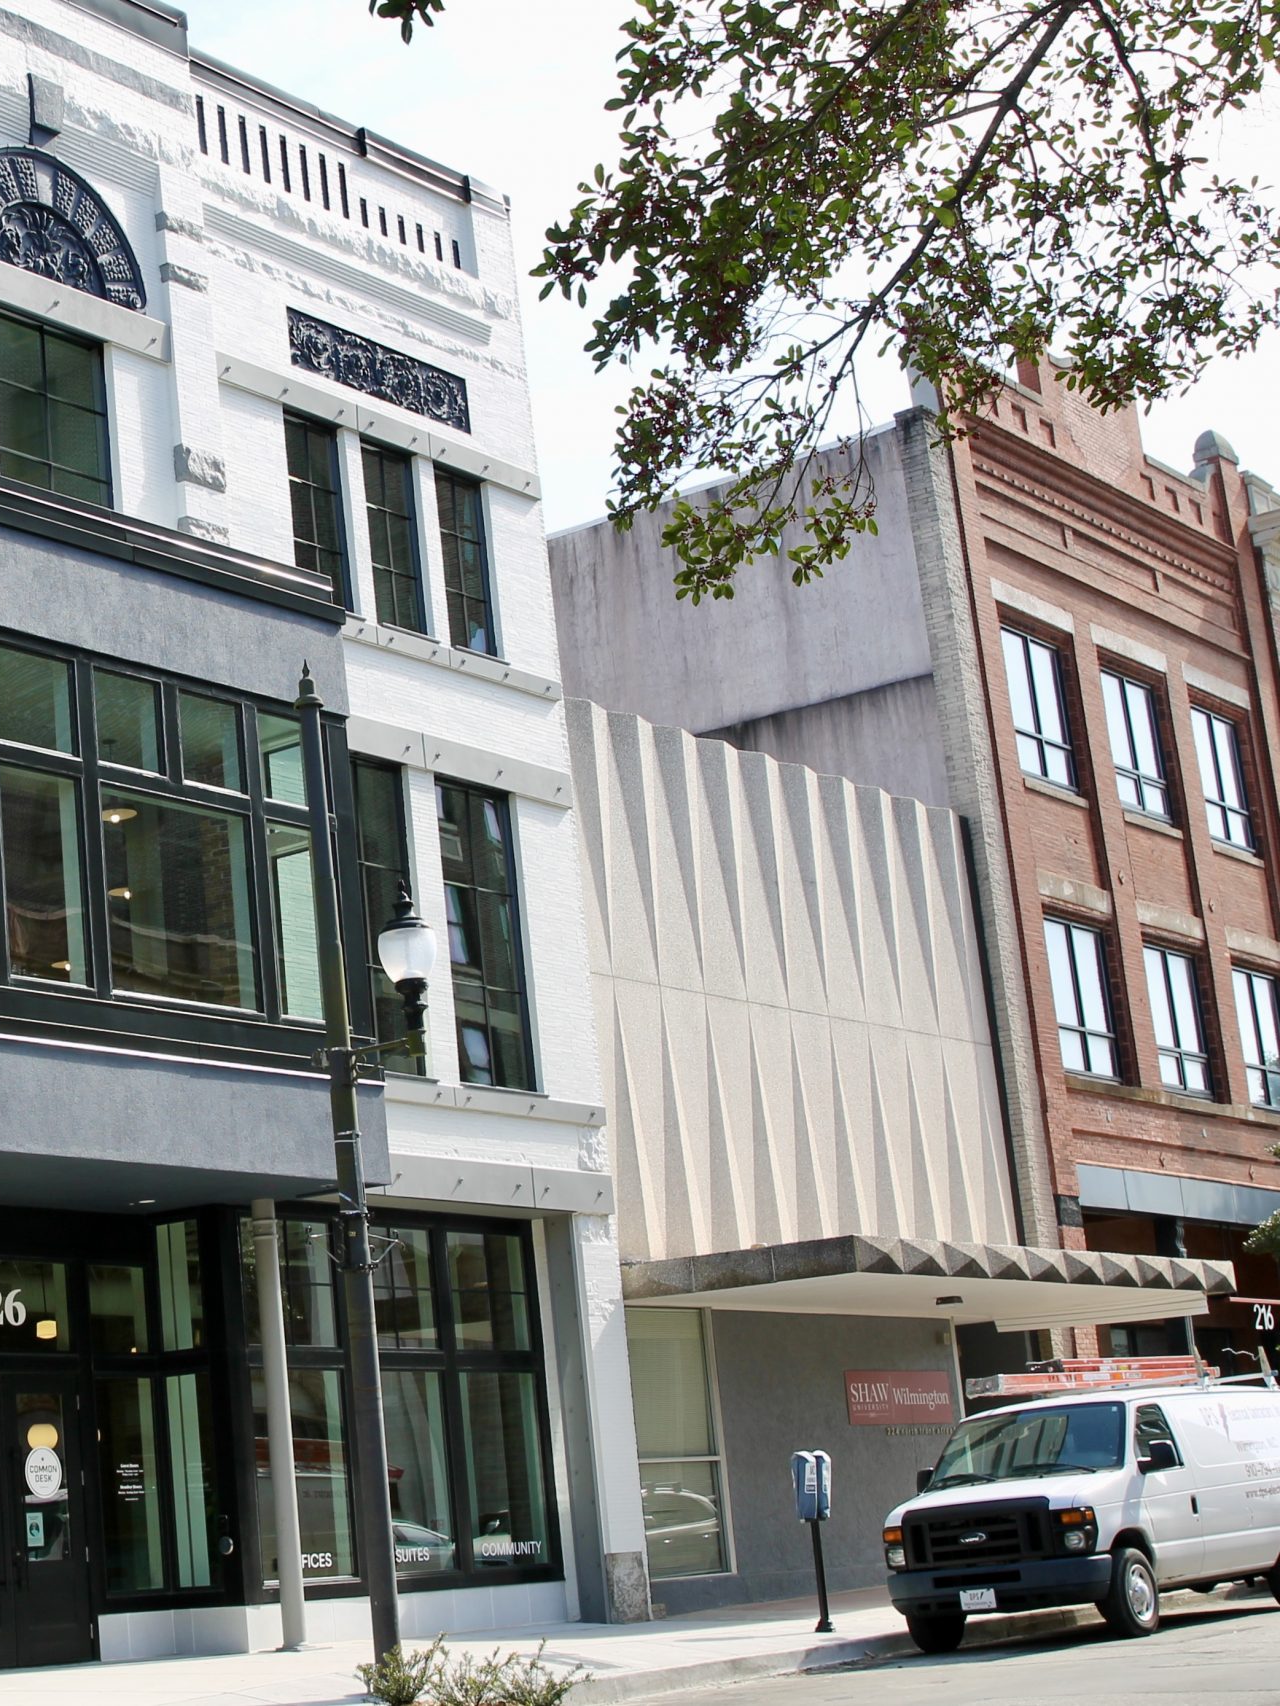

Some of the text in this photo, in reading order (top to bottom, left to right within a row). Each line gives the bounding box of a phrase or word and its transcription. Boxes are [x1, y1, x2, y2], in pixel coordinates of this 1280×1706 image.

[1253, 1303, 1274, 1330] 216
[850, 1382, 949, 1410] SHAW Wilmington
[852, 1403, 889, 1411] UNIVERSITY
[29, 1465, 58, 1474] COMMON
[34, 1474, 53, 1483] DESK
[395, 1547, 430, 1563] SUITES
[481, 1541, 542, 1557] COMMUNITY
[302, 1552, 332, 1569] FICES
